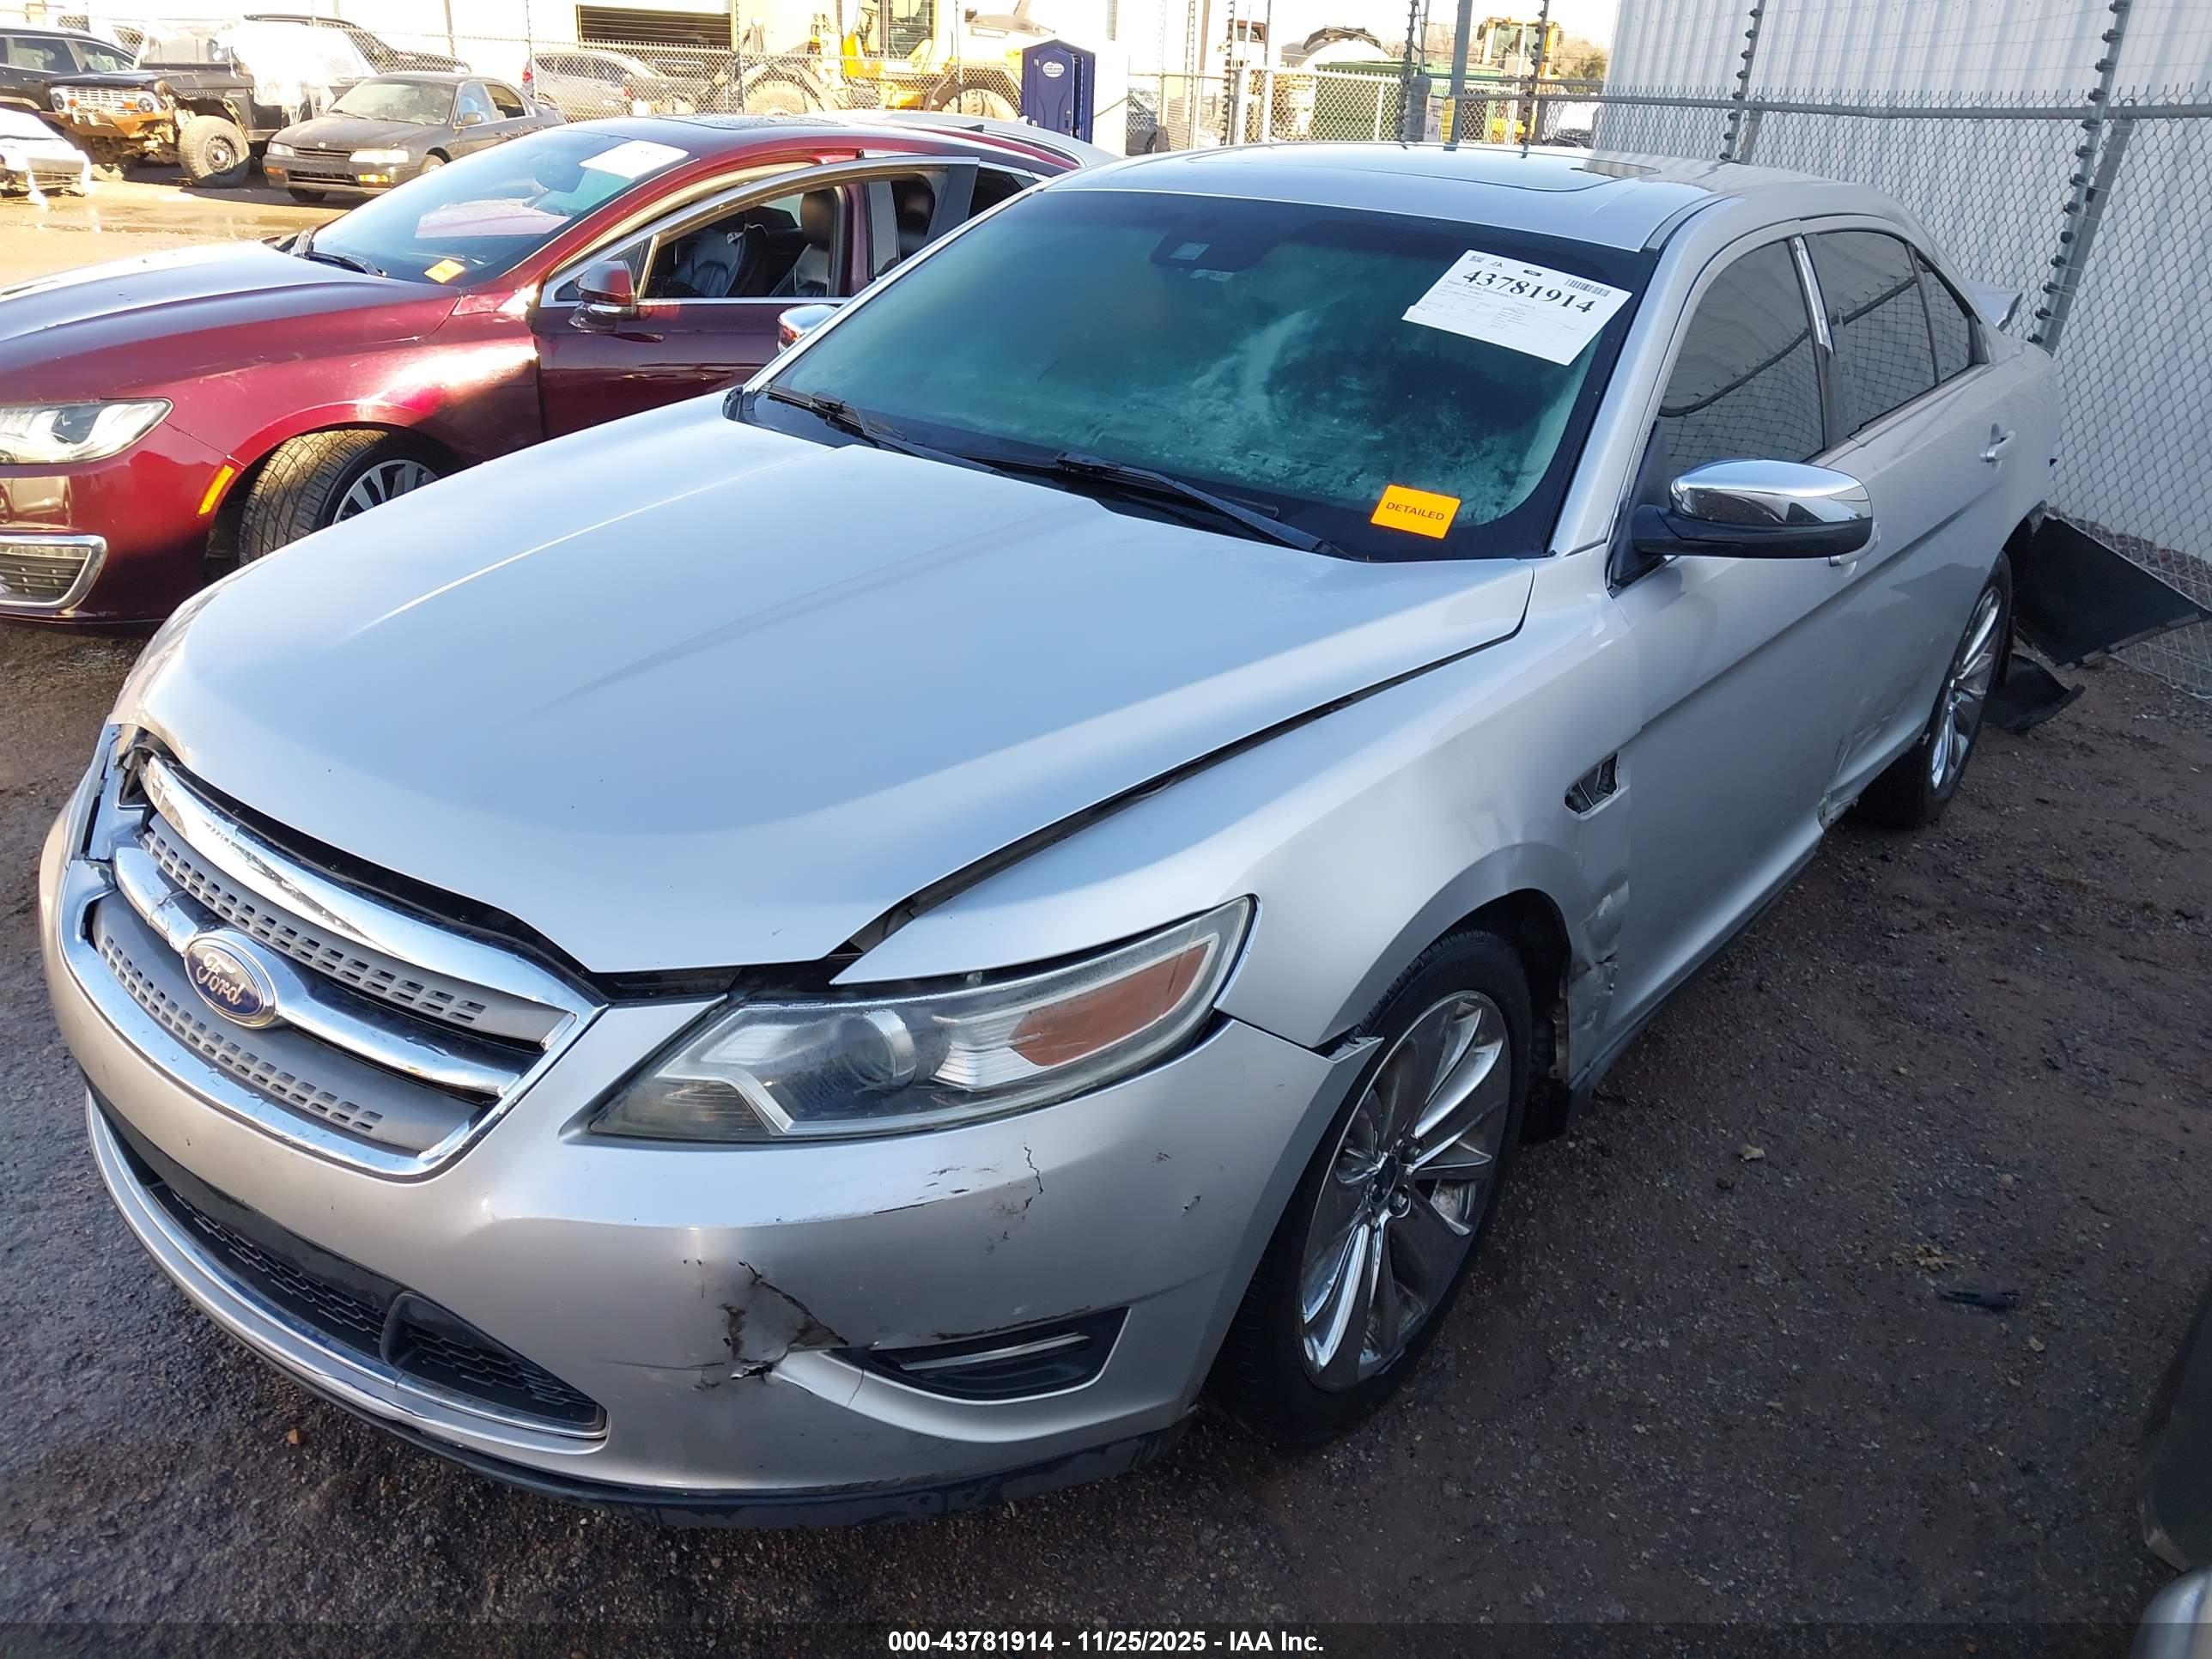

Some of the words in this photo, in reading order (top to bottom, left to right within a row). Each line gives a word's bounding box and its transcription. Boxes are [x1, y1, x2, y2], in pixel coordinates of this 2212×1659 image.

[1462, 270, 1596, 313] 43781914
[1385, 501, 1445, 520] DETAILED
[196, 951, 245, 1005] Ford
